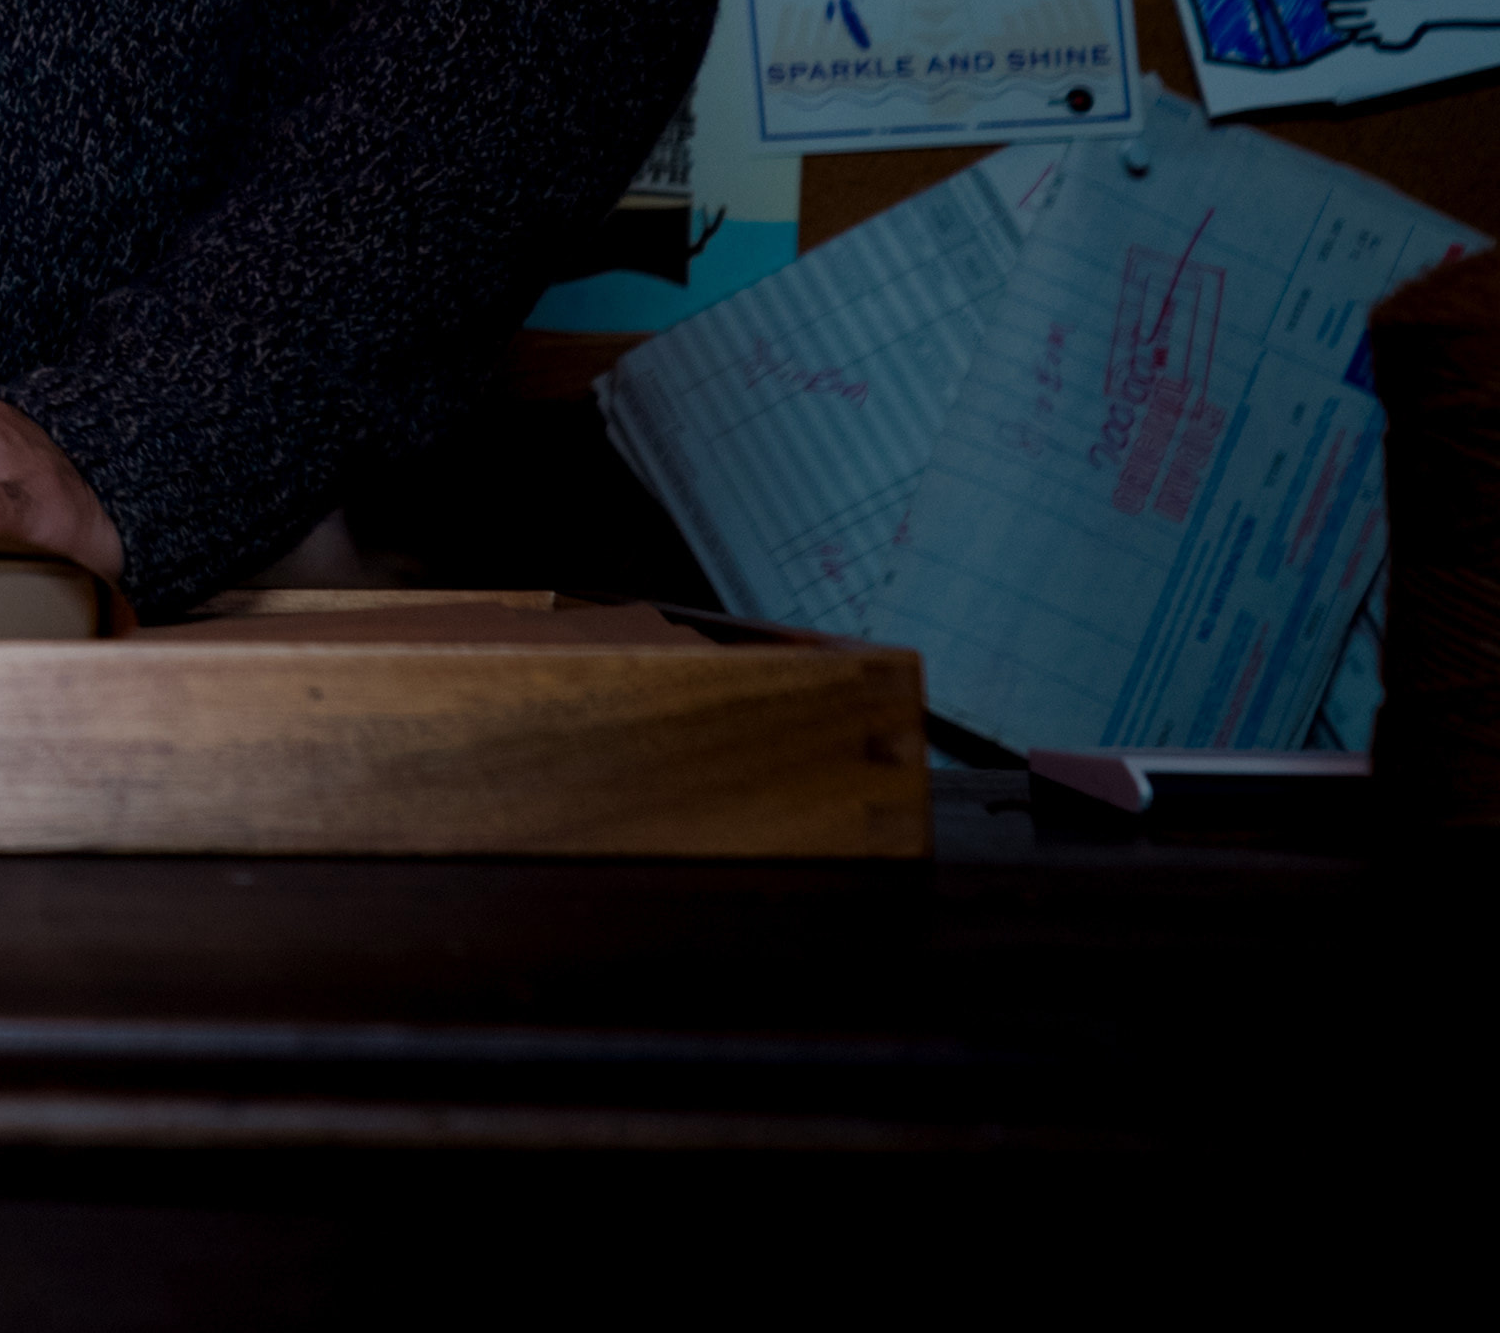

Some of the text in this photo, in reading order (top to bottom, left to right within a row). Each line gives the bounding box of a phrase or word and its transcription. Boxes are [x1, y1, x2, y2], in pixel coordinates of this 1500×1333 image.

[766, 44, 1111, 85] SPARKLE AND SHINE
